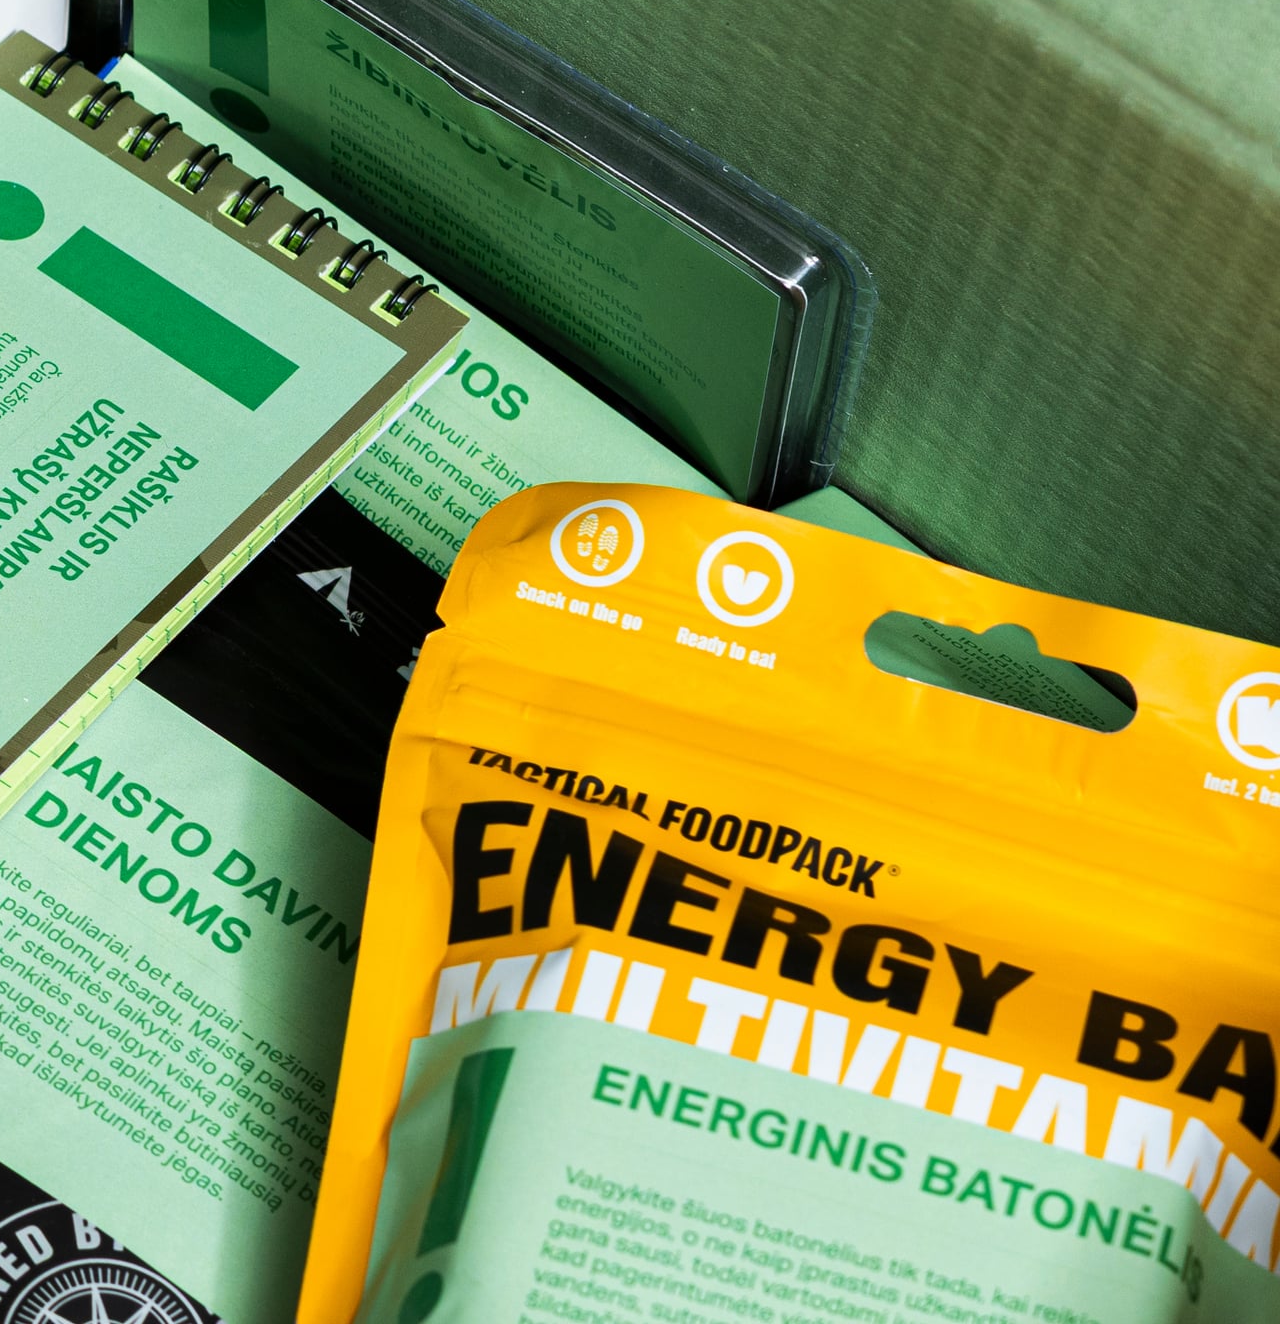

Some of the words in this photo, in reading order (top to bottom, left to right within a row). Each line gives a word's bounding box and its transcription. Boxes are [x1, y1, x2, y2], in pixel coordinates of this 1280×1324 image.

[27, 359, 63, 383] Čia
[11, 398, 125, 494] UŽRAŠŲ
[465, 440, 482, 458] ir
[78, 445, 199, 555] RAŠIKLIS
[423, 481, 444, 501] iš
[47, 548, 91, 581] IR
[515, 580, 566, 611] Snack
[568, 598, 591, 617] on
[592, 602, 619, 625] the
[621, 612, 644, 633] go
[675, 626, 727, 657] Ready
[728, 641, 747, 661] to
[748, 650, 778, 670] eat
[465, 745, 651, 822] TACTICAL
[1243, 782, 1258, 802] 2
[23, 789, 252, 954] DIENOMS
[447, 800, 1036, 1037] ENERGY
[1075, 988, 1280, 1164] BA
[31, 1062, 165, 1157] išlaikytumėte
[159, 1153, 222, 1201] jėgas.
[46, 1039, 84, 1073] bet
[80, 1067, 173, 1132] pasilikite
[173, 1125, 282, 1213] būtiniausią
[592, 1063, 908, 1183] ENERGINIS
[565, 1165, 676, 1212] Valgykite
[680, 1198, 747, 1234] šiuos
[751, 1219, 882, 1272] batonėlius
[888, 1259, 917, 1280] tik
[924, 1269, 982, 1302] tada,
